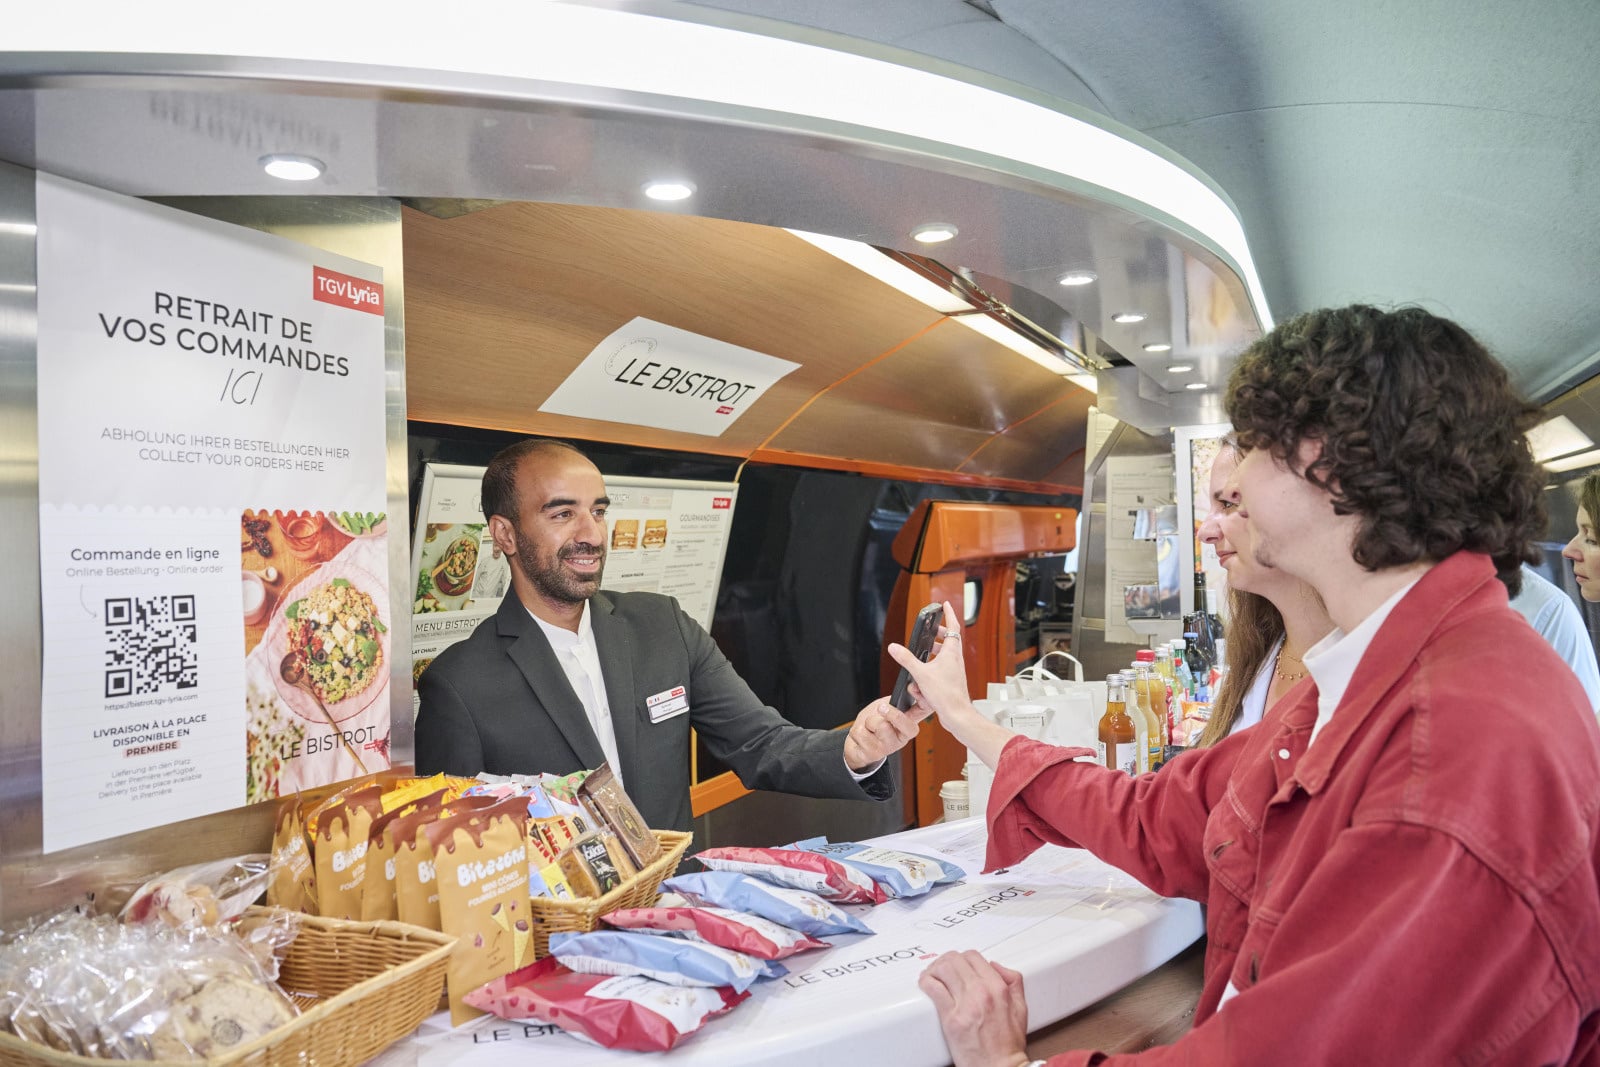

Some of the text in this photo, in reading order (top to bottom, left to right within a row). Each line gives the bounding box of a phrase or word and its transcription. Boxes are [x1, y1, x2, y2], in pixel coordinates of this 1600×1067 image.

[317, 275, 380, 305] TGV Lyria
[154, 291, 312, 344] RETRAIT DE
[98, 312, 349, 377] VOS COMMANDES
[220, 368, 263, 405] ICI
[614, 358, 756, 405] LE BISTROT
[100, 427, 350, 459] ABHOLUNG IHRER BESTELLUNGEN HIER
[138, 448, 325, 472] COLLECT YOUR ORDERS HERE
[71, 547, 220, 562] Commande en ligne
[65, 564, 223, 578] Online Bestellung Online order
[415, 622, 443, 633] MENU
[445, 617, 481, 630] BISTROT
[93, 714, 207, 739] LIVRAISON À LA PLACE
[113, 728, 190, 748] DISPONIBLE EN
[279, 725, 376, 761] LE BISTROT
[946, 803, 956, 811] LE
[933, 886, 1028, 929] LE BISTROT
[783, 945, 926, 989] LE BISTROT
[473, 1027, 512, 1044] LE
